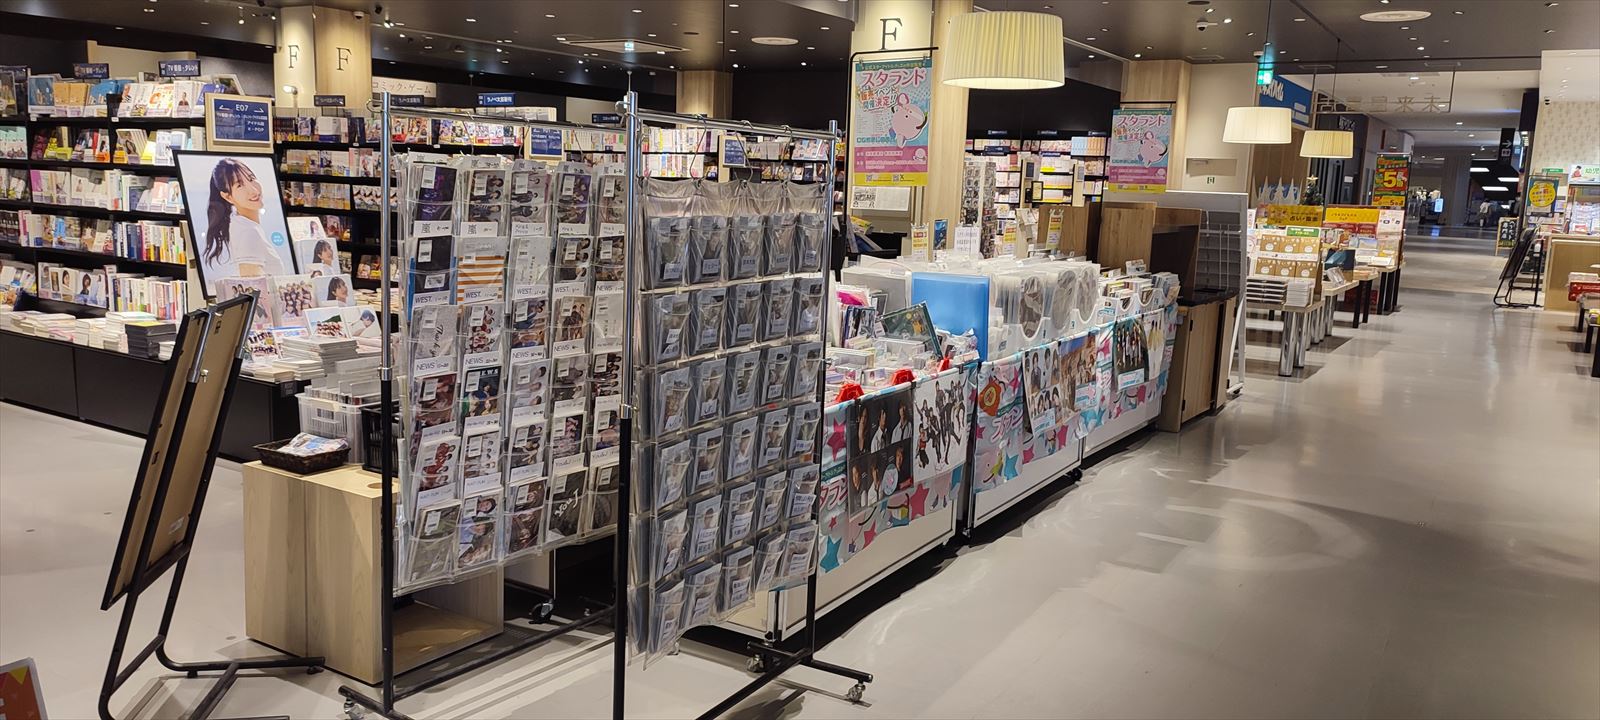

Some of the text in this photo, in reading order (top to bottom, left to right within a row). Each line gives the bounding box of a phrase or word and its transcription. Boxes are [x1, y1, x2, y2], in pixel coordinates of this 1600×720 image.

[879, 17, 903, 50] F
[288, 44, 300, 69] F
[336, 46, 352, 72] F
[861, 67, 927, 88] スタランド
[372, 81, 431, 95] コミック・ゲーム
[235, 104, 249, 112] E07
[1117, 114, 1167, 127] スタランド
[596, 284, 613, 292] NEWS
[553, 344, 570, 352] NEWS
[512, 350, 529, 359] NEWS
[415, 361, 436, 371] NEWS
[464, 356, 484, 366] NEWS
[480, 368, 499, 377] EWS
